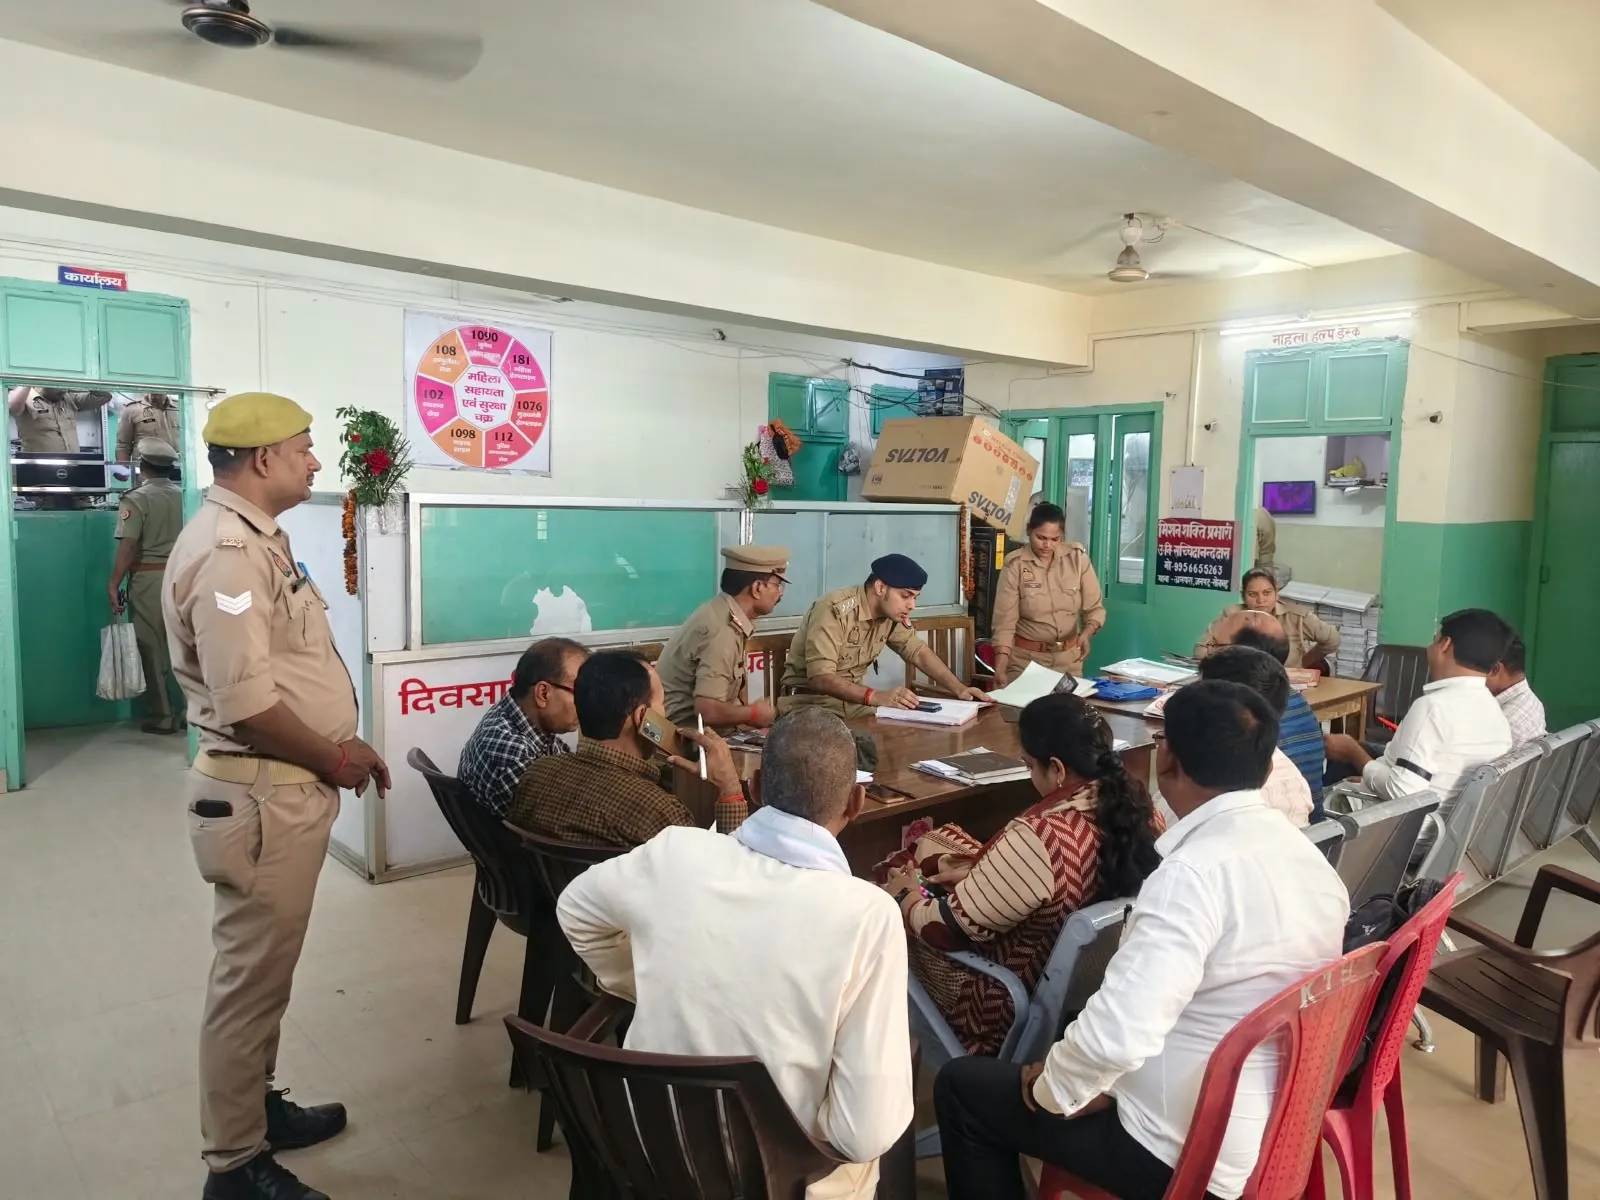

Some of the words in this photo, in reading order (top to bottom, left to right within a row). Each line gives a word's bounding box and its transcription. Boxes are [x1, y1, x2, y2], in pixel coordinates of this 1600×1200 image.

[64, 272, 122, 286] कार्यालय
[472, 330, 498, 342] 1090
[436, 345, 456, 356] 108
[513, 355, 530, 365] 181
[468, 371, 500, 384] महिला
[424, 390, 444, 400] 102
[464, 386, 504, 397] सहायता
[462, 398, 476, 408] एवं
[479, 401, 506, 412] सुरक्षा
[518, 400, 542, 412] 1076
[474, 414, 494, 423] चक्र
[450, 428, 476, 438] 1098
[495, 432, 513, 442] 112
[885, 448, 950, 463] VOLTAS
[968, 490, 1012, 526] VOLTAS
[1158, 520, 1181, 538] मिशन
[1182, 522, 1206, 539] शक्ति
